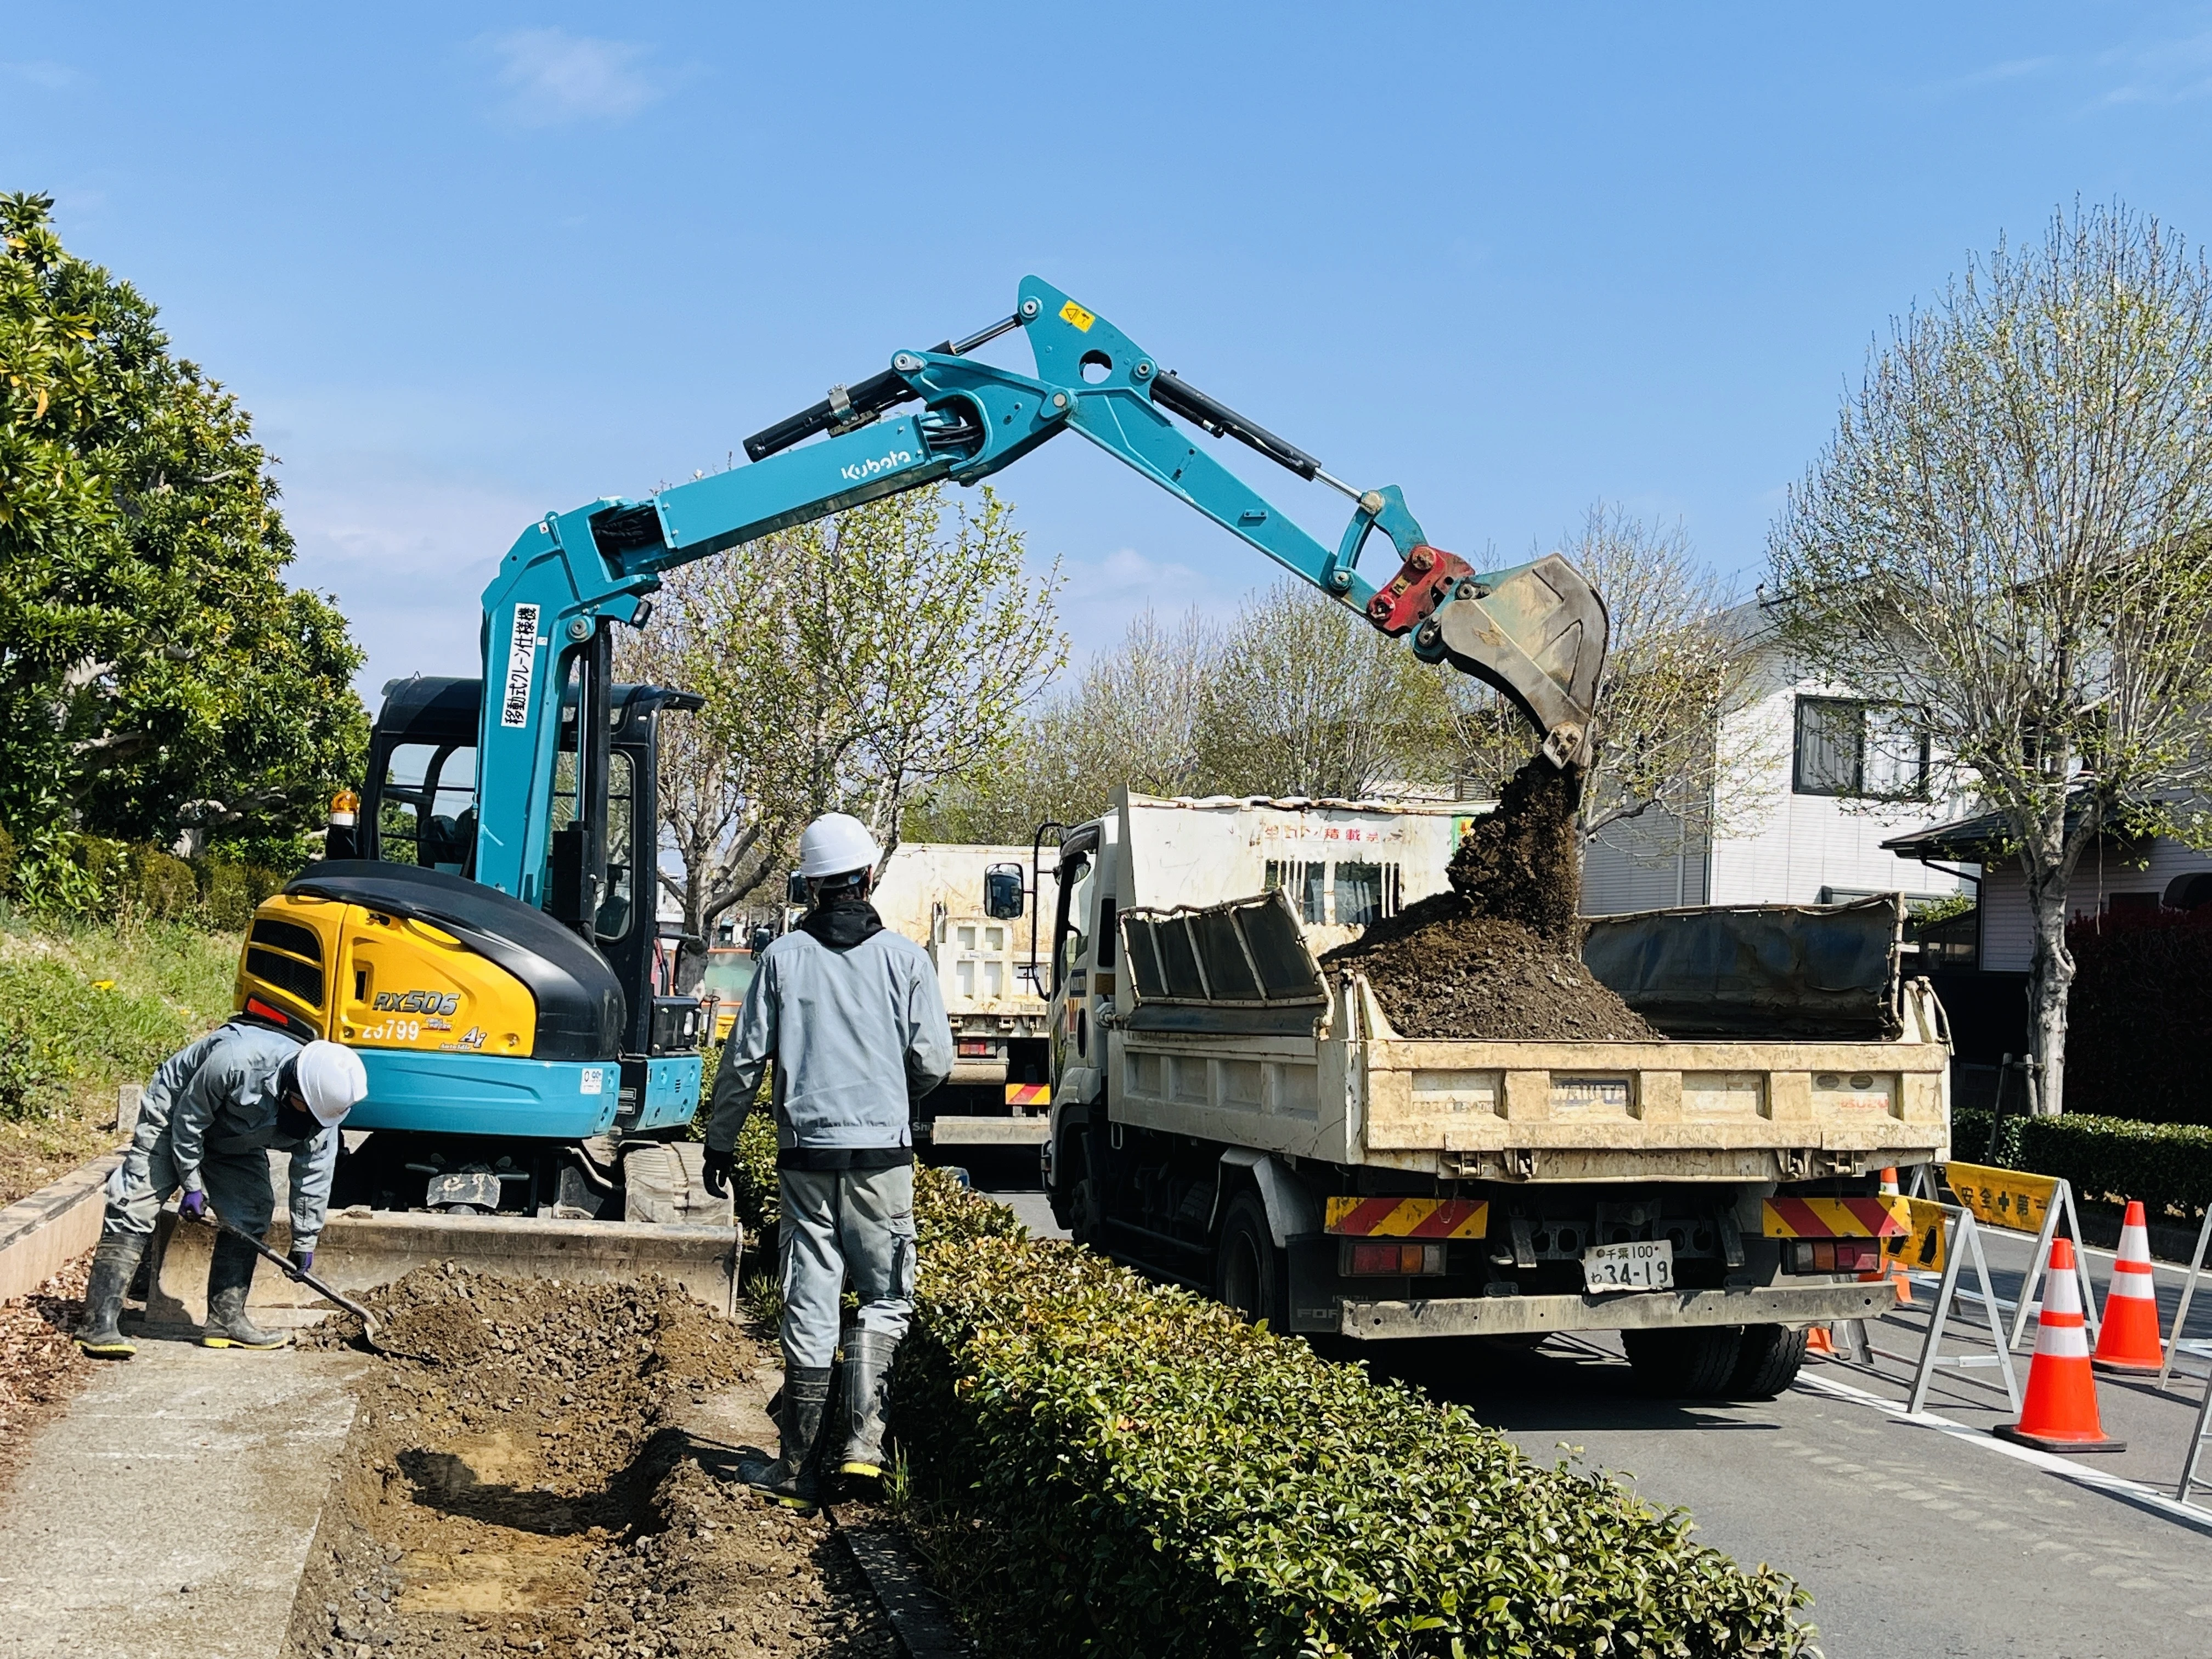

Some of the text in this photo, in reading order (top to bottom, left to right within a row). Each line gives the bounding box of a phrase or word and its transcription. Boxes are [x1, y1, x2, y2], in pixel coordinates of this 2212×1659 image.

[841, 450, 911, 480] Kubota
[505, 607, 537, 725] 移動式クレーン仕様機
[372, 990, 461, 1016] RX506
[1606, 1245, 1653, 1261] 千葉 100
[1604, 1261, 1668, 1286] 34-19
